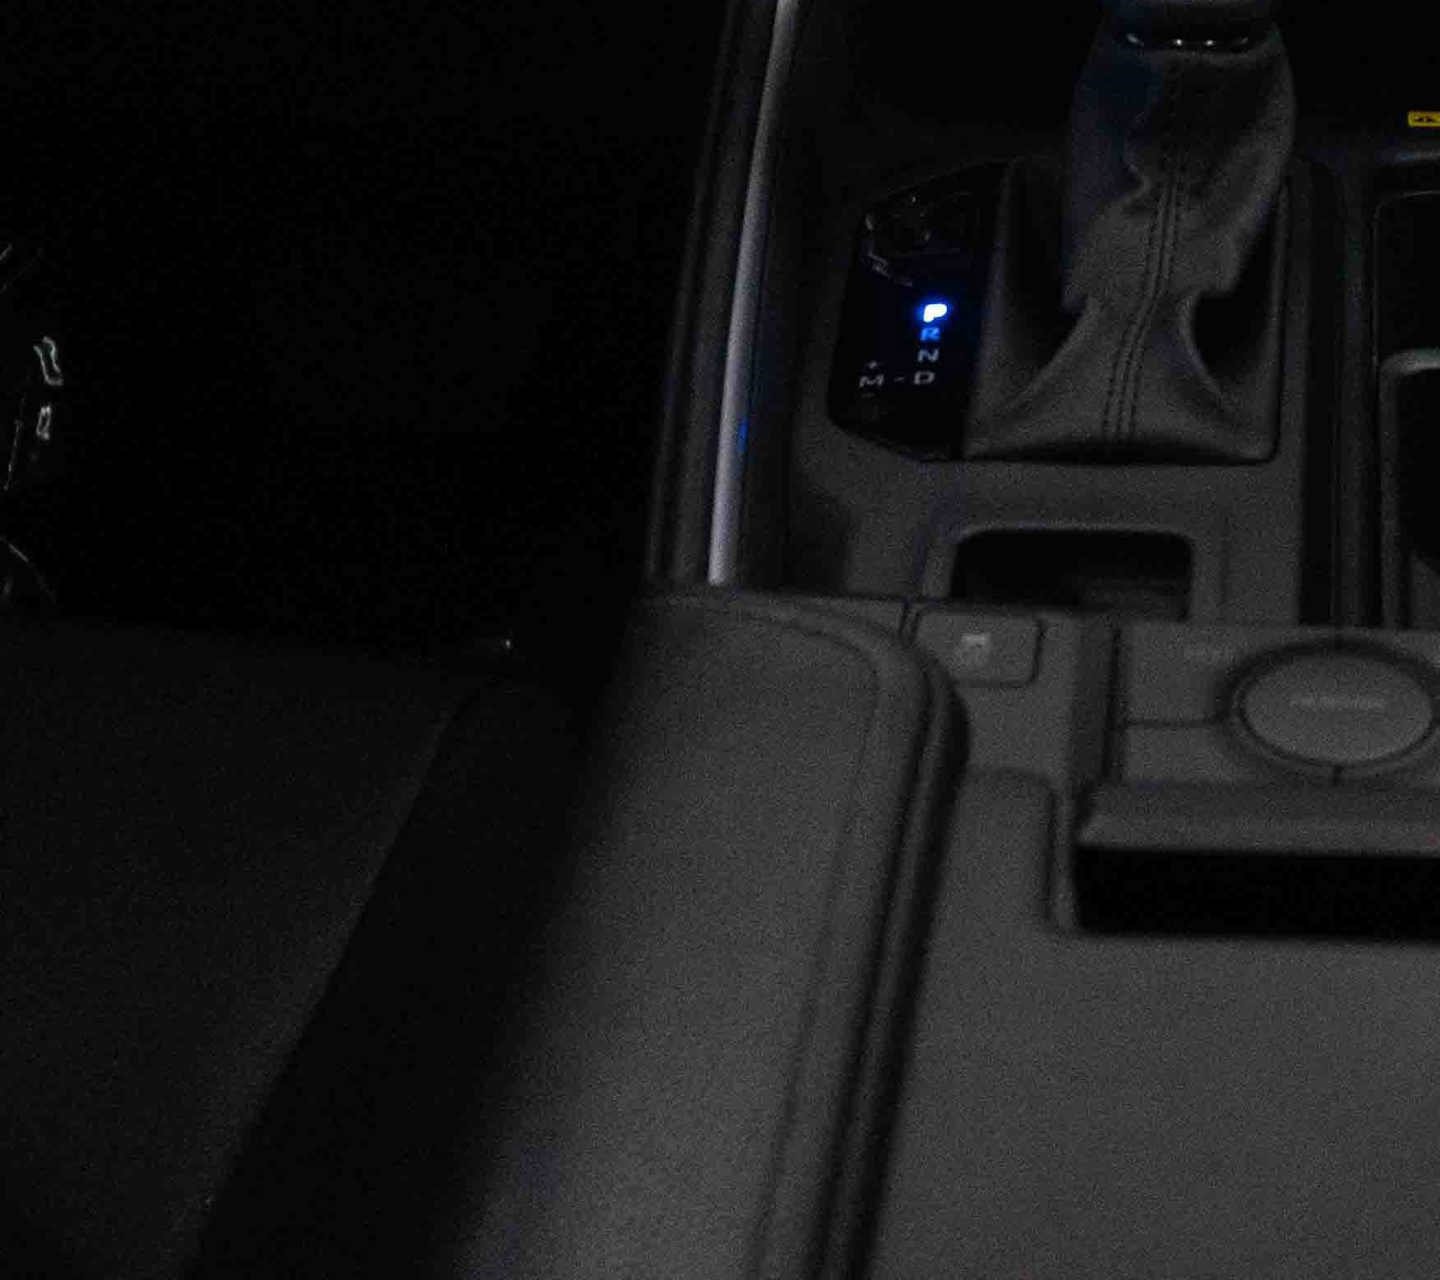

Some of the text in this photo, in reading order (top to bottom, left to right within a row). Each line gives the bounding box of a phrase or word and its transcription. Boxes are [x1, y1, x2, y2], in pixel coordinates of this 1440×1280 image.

[922, 302, 948, 324] P
[917, 348, 940, 363] N
[858, 373, 885, 388] M
[913, 370, 937, 386] D
